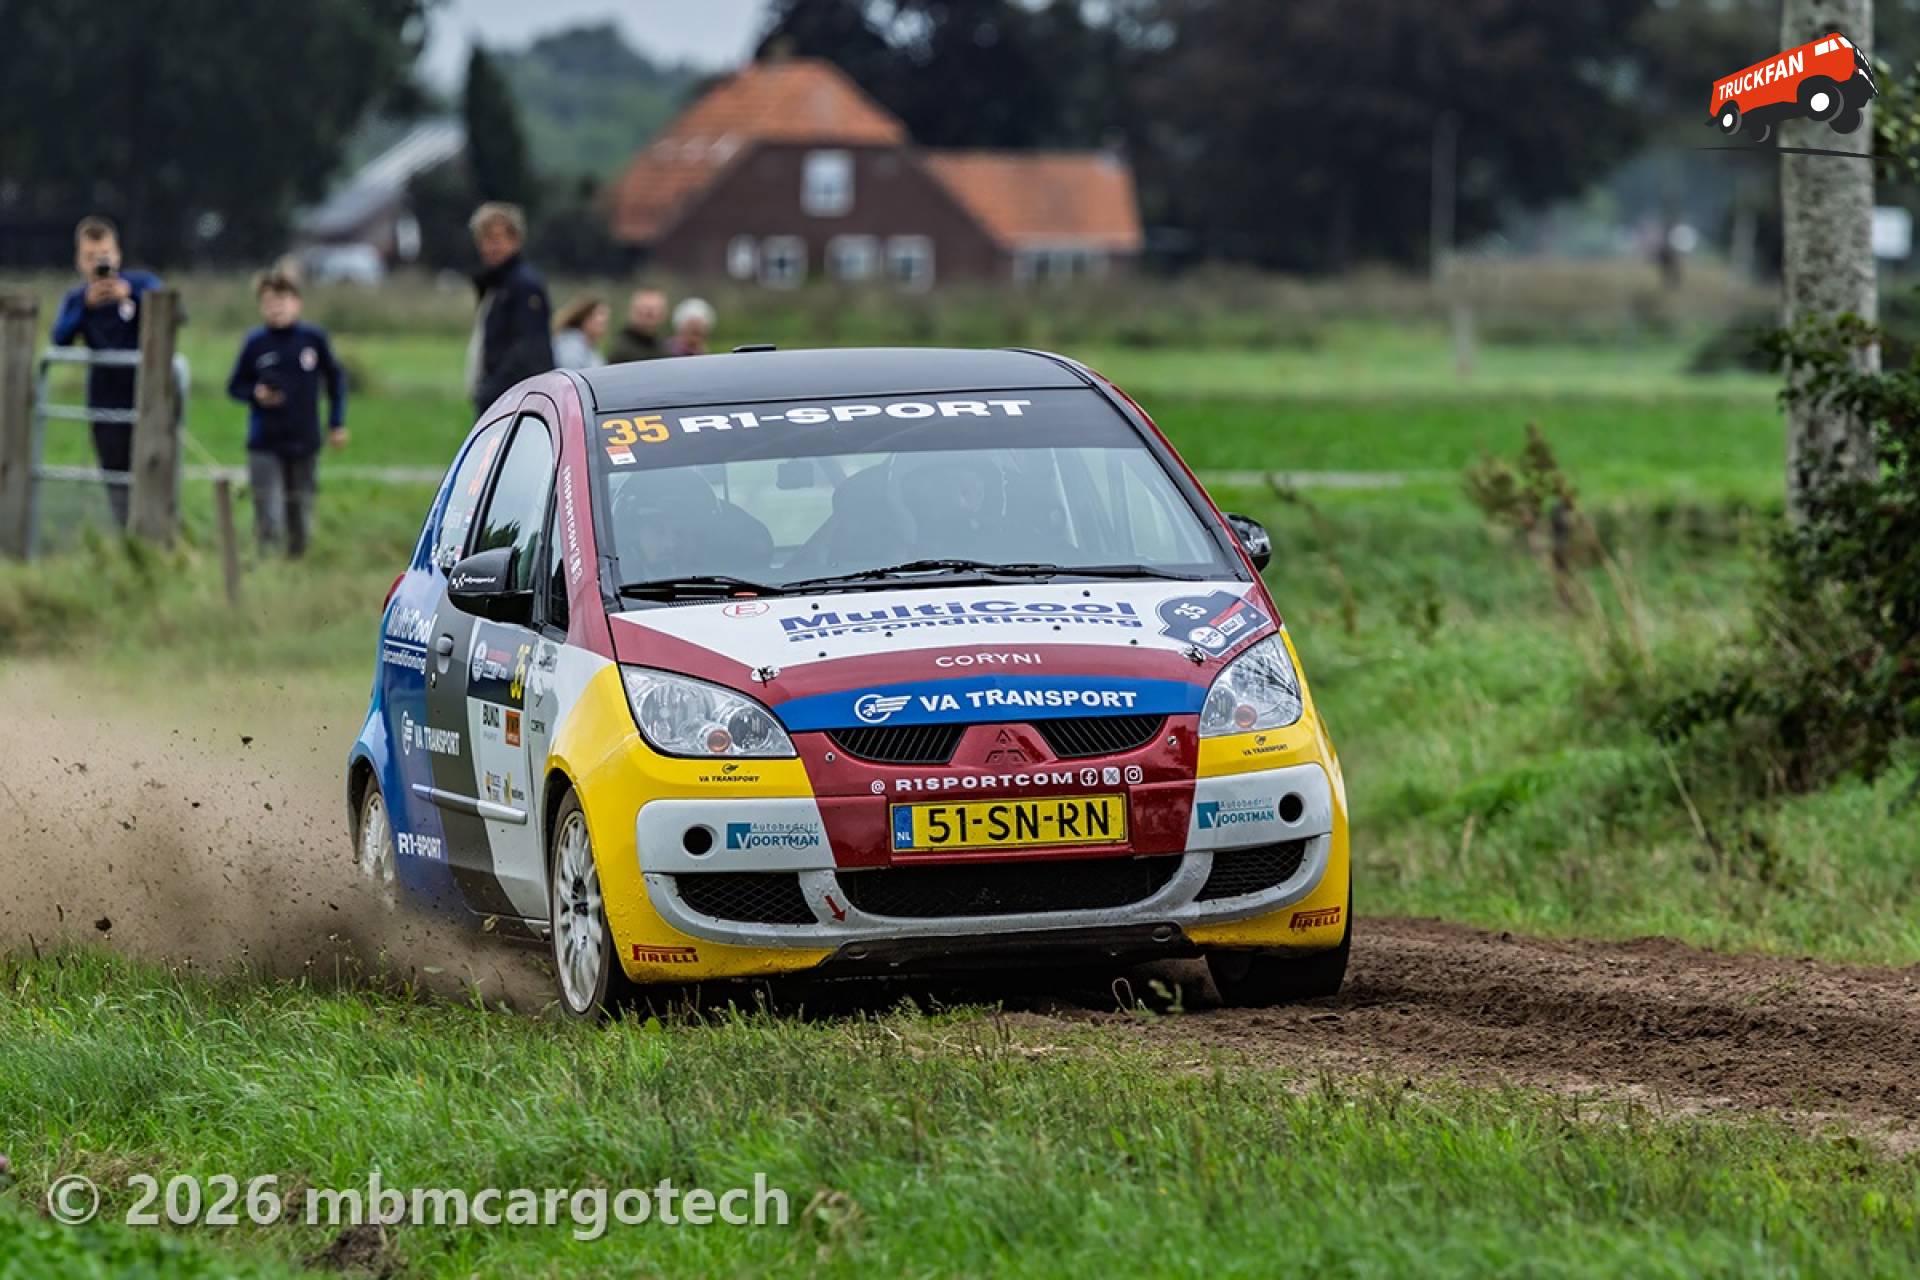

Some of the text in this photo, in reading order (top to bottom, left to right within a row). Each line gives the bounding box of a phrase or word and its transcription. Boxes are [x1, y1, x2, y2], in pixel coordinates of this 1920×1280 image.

[678, 399, 1032, 433] R1-SPORT
[602, 415, 670, 446] 35
[780, 600, 1137, 631] MultiCool
[786, 615, 1143, 643] airconditioning
[935, 652, 1043, 668] CORYNI
[919, 689, 1137, 712] VA TRANSPORT
[895, 771, 1073, 792] R1SPORTCOM
[927, 800, 1110, 843] 51-SN-RN
[1206, 810, 1275, 828] VOORTMAN
[397, 832, 441, 859] R1-SPORT
[735, 833, 820, 849] VOORTMAN
[896, 831, 912, 841] NL
[1289, 906, 1341, 929] PIRELLI
[632, 944, 699, 964] PIRELLI
